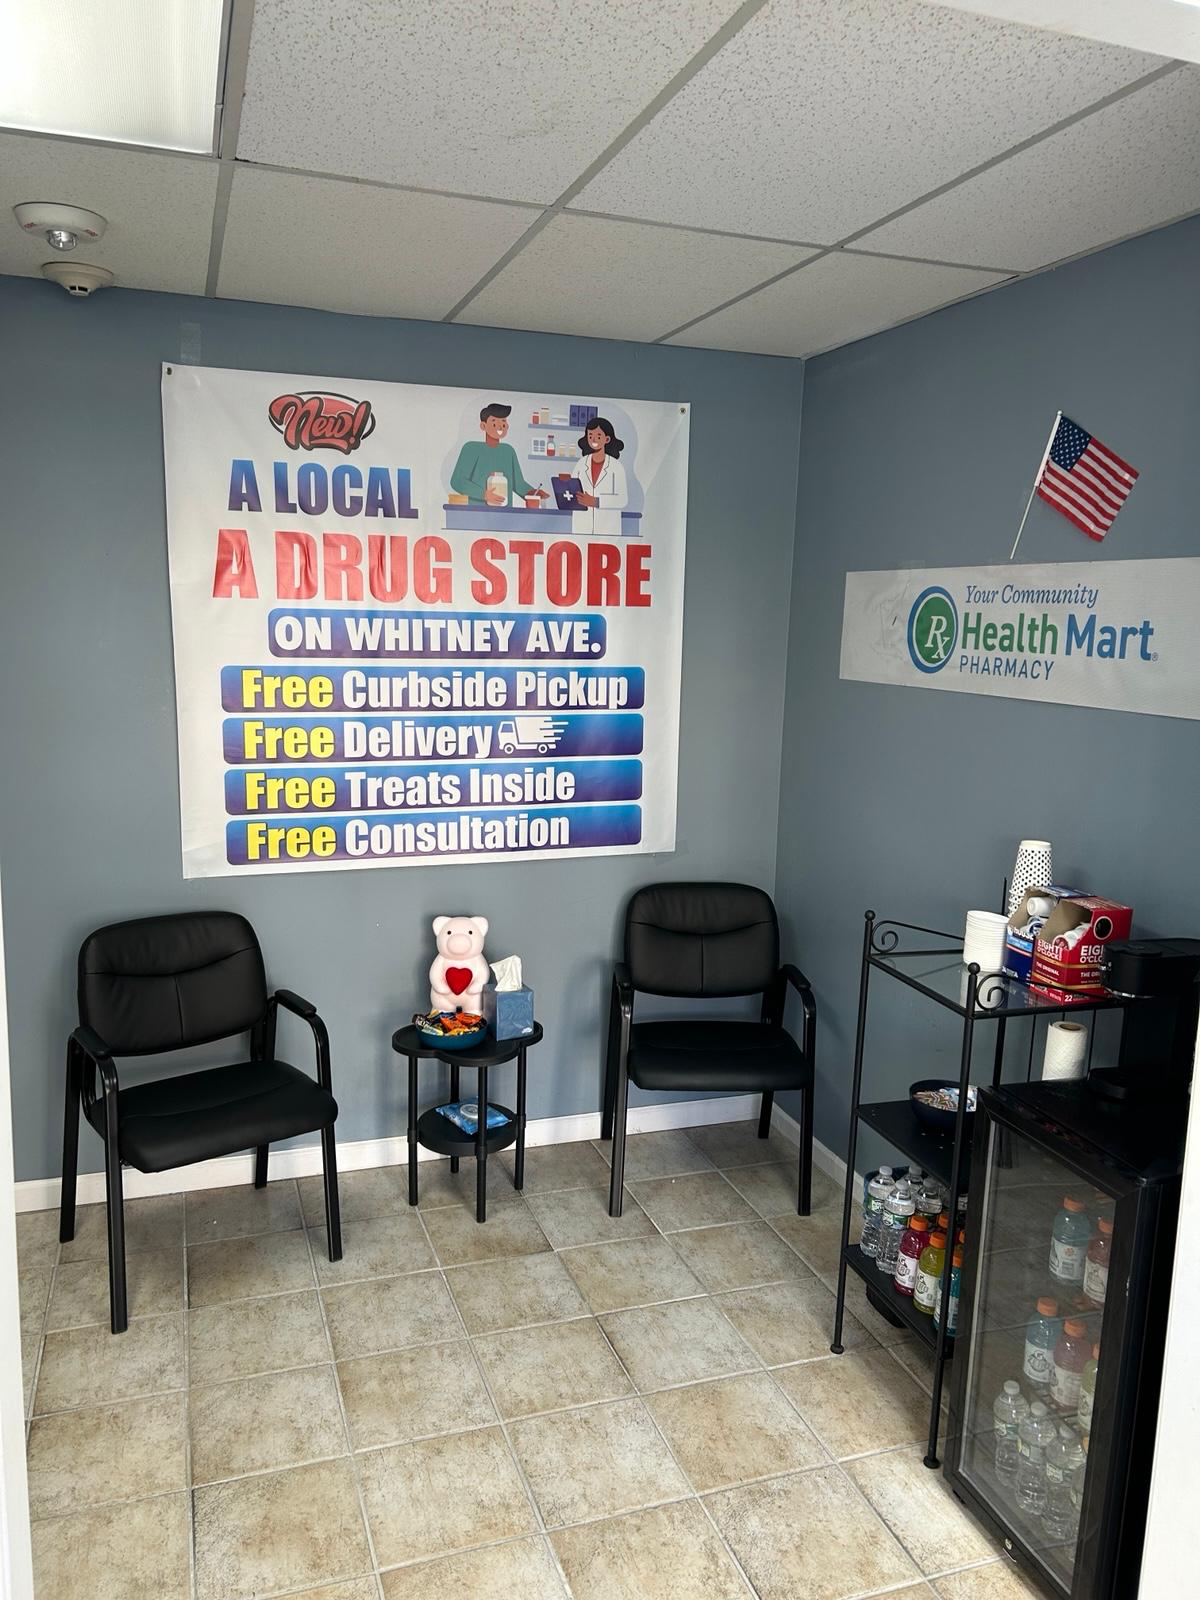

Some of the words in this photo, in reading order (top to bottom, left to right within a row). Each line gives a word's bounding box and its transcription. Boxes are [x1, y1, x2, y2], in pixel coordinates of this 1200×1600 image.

[269, 394, 371, 453] New!
[228, 459, 262, 512] A
[273, 461, 419, 519] LOCAL
[212, 529, 259, 599] A
[275, 531, 453, 604] DRUG
[470, 538, 652, 607] STORE
[965, 585, 999, 604] Your
[1001, 584, 1099, 608] Community
[274, 615, 332, 651] ON
[344, 617, 516, 653] WHITNEY
[525, 620, 602, 653] AVE.
[961, 612, 1059, 655] Health
[1065, 613, 1154, 661] Mart
[959, 654, 1055, 681] PHARMACY
[241, 668, 334, 709] Free
[342, 670, 507, 708] Curbside
[516, 671, 629, 710] Pickup
[243, 720, 336, 760] Free
[343, 720, 493, 759] Delivery
[245, 771, 337, 811] Free
[345, 771, 462, 808] Treats
[469, 766, 576, 804] Inside
[247, 821, 338, 861] Free
[345, 813, 570, 857] Consultation
[1037, 938, 1061, 955] EIGHT
[1080, 944, 1104, 957] EIG
[1080, 955, 1104, 964] O'CLO
[1064, 994, 1073, 1002] 22
